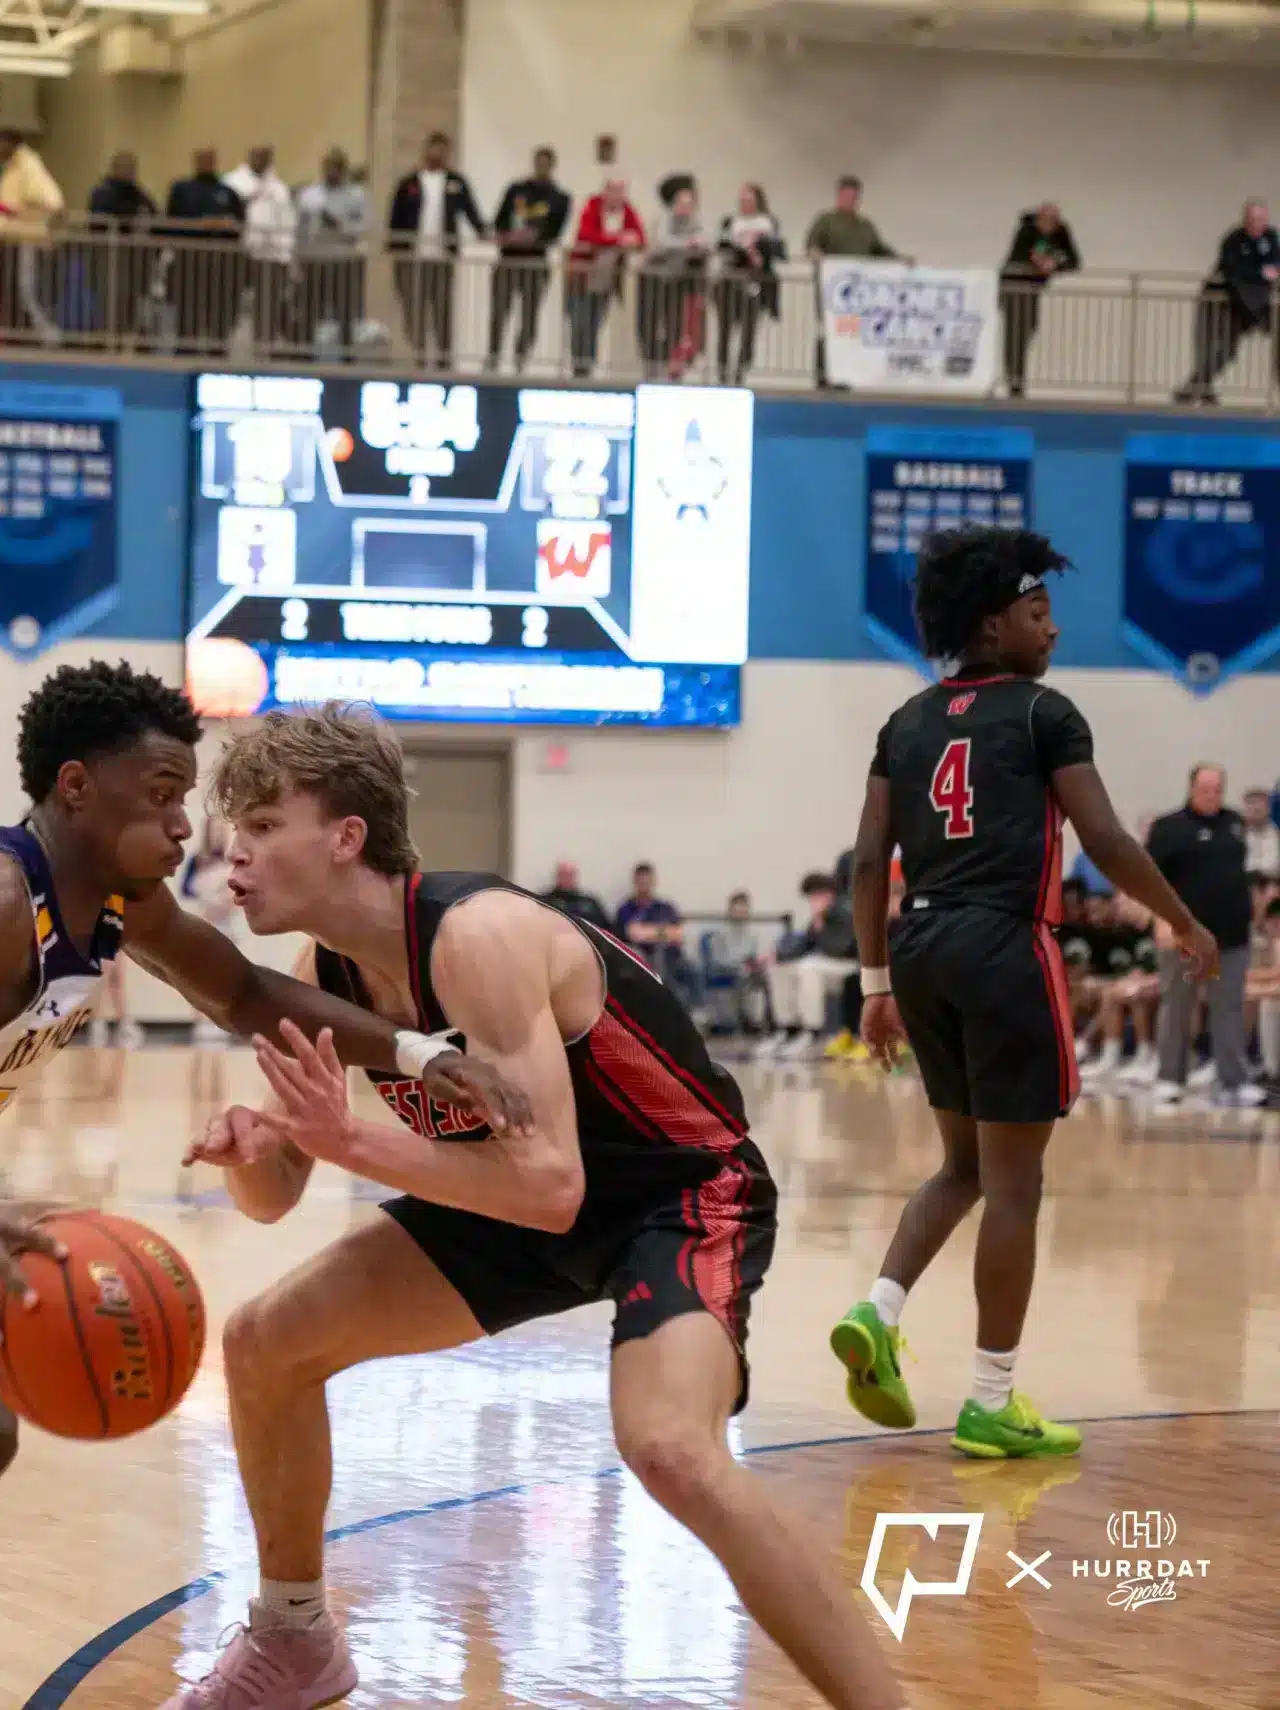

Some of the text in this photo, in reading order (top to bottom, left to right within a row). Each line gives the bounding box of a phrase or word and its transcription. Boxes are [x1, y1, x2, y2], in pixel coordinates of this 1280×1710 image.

[894, 461, 1005, 490] BASEBALL
[1170, 470, 1244, 497] TRACK
[929, 737, 974, 840] 4
